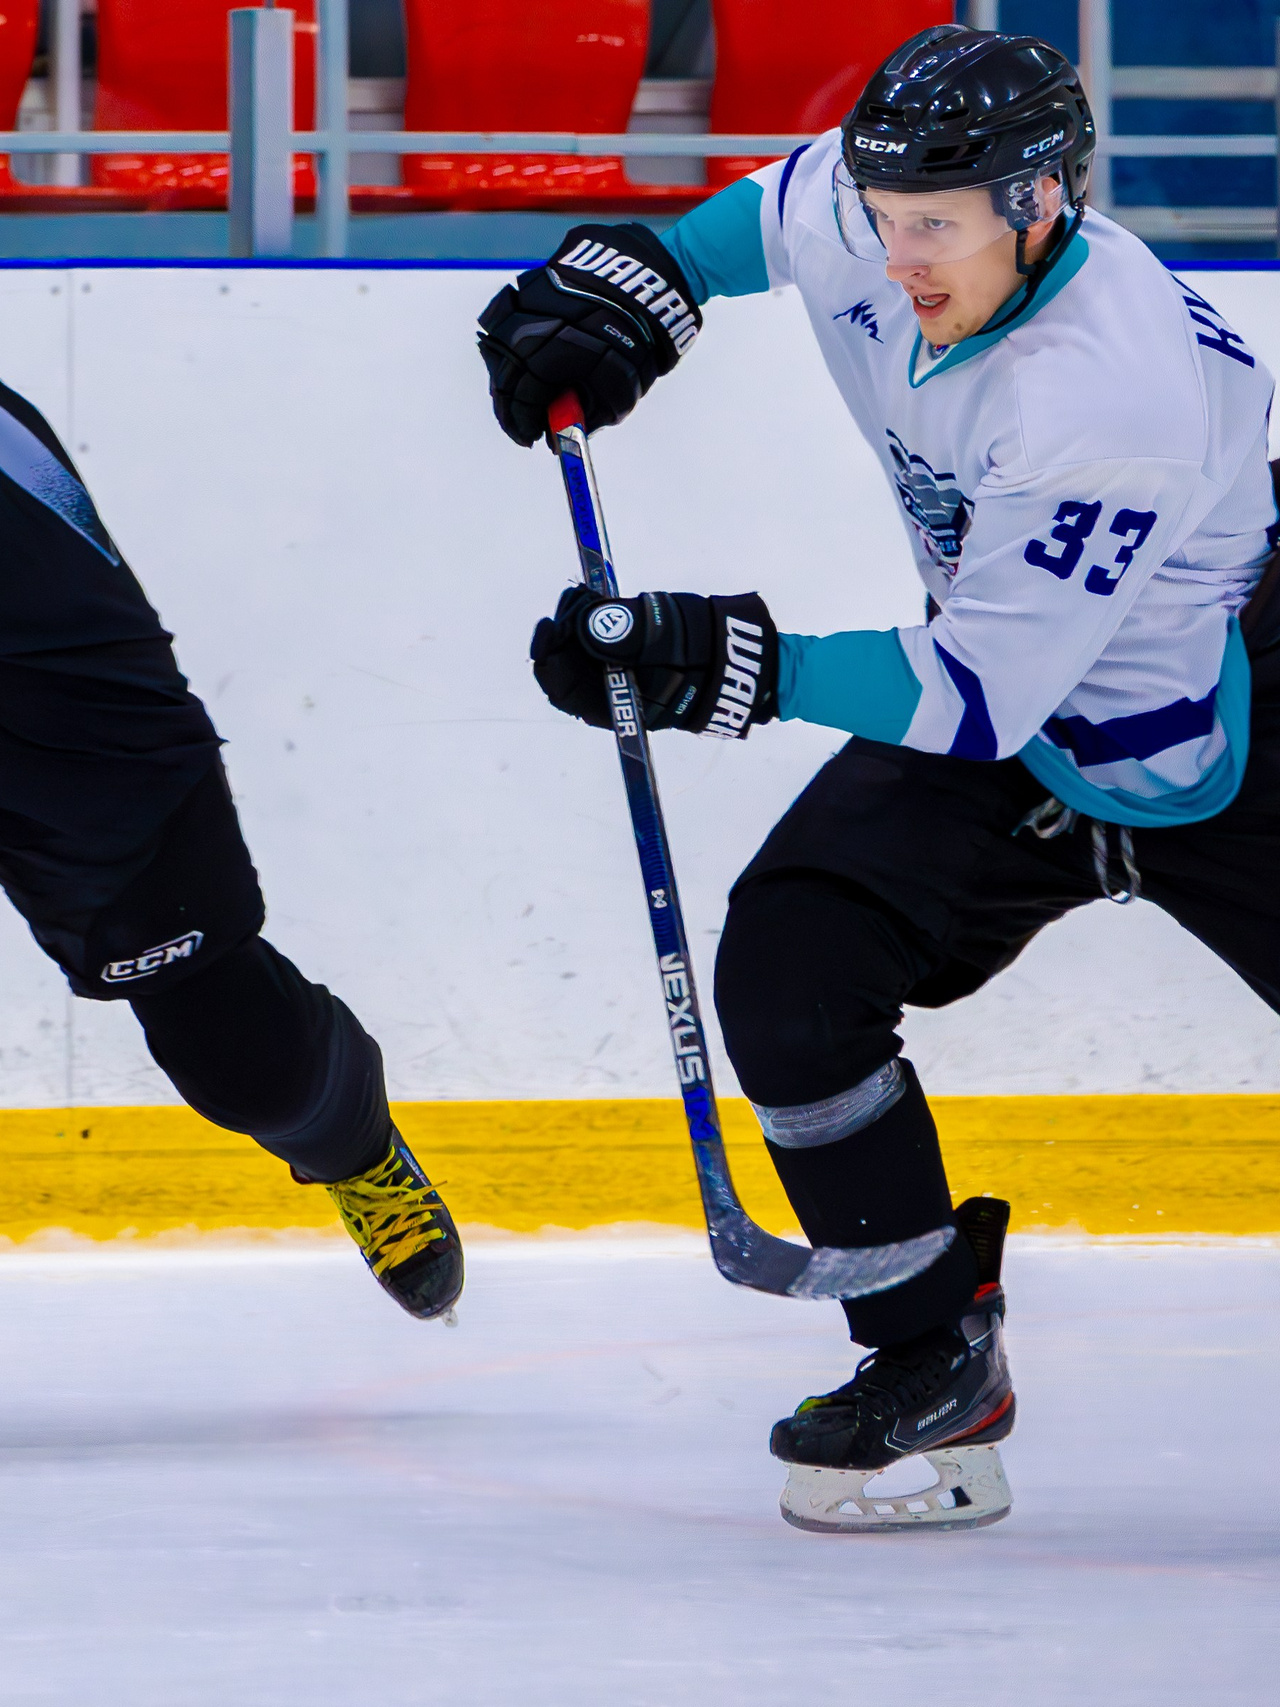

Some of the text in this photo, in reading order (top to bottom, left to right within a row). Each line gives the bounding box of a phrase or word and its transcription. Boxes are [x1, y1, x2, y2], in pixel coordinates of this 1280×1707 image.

[854, 135, 908, 154] CCM
[1022, 130, 1065, 159] CCM
[1024, 500, 1158, 596] 33
[110, 940, 194, 977] CCM
[660, 952, 706, 1085] NEXUS
[917, 1398, 958, 1431] BAUER
